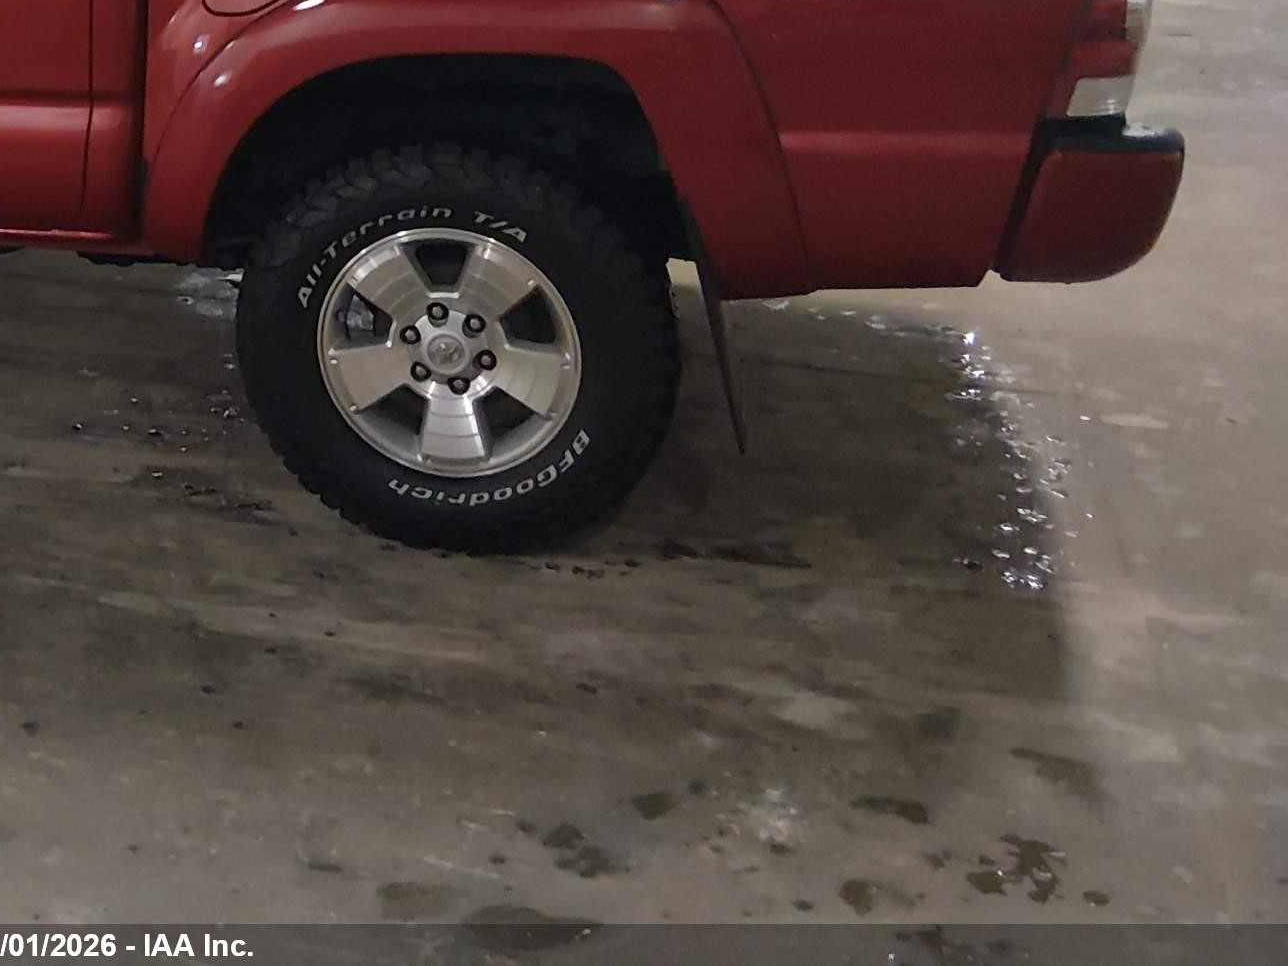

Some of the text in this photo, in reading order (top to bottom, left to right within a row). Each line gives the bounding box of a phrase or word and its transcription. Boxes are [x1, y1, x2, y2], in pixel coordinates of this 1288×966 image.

[297, 206, 528, 309] All-Terrain T/A
[387, 428, 590, 507] BFGoodrich
